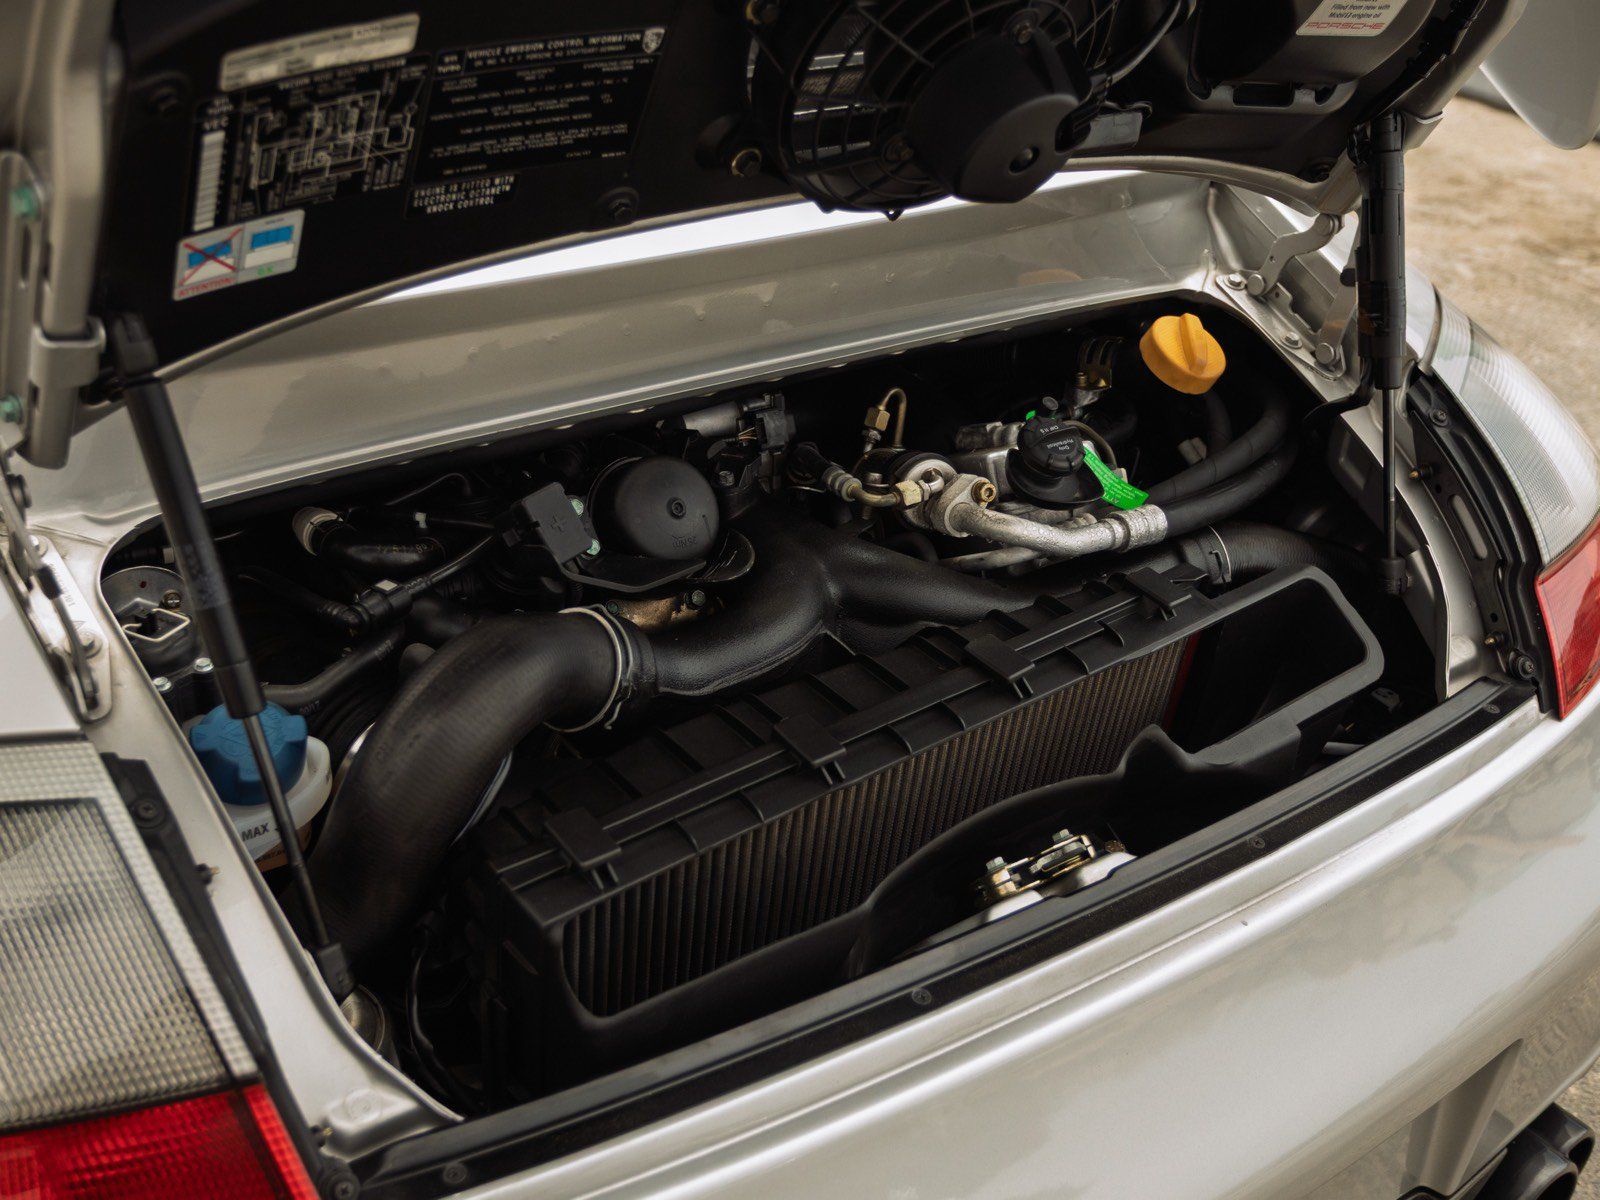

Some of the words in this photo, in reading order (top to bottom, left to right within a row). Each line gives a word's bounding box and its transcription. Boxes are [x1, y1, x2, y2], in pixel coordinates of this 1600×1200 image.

[1305, 22, 1385, 30] PORSCHE
[465, 46, 502, 60] VEHICLE
[504, 42, 545, 55] EMISSION
[546, 37, 584, 51] CONTROL
[587, 32, 642, 46] INFORMATION
[414, 185, 446, 199] ENGINE
[449, 183, 459, 193] IS
[461, 178, 491, 190] FITTED
[494, 174, 514, 186] WITH
[413, 191, 466, 208] ELECTRONIC
[426, 202, 455, 215] KNOCK
[457, 195, 494, 210] CONTROL
[241, 822, 270, 842] MAX
